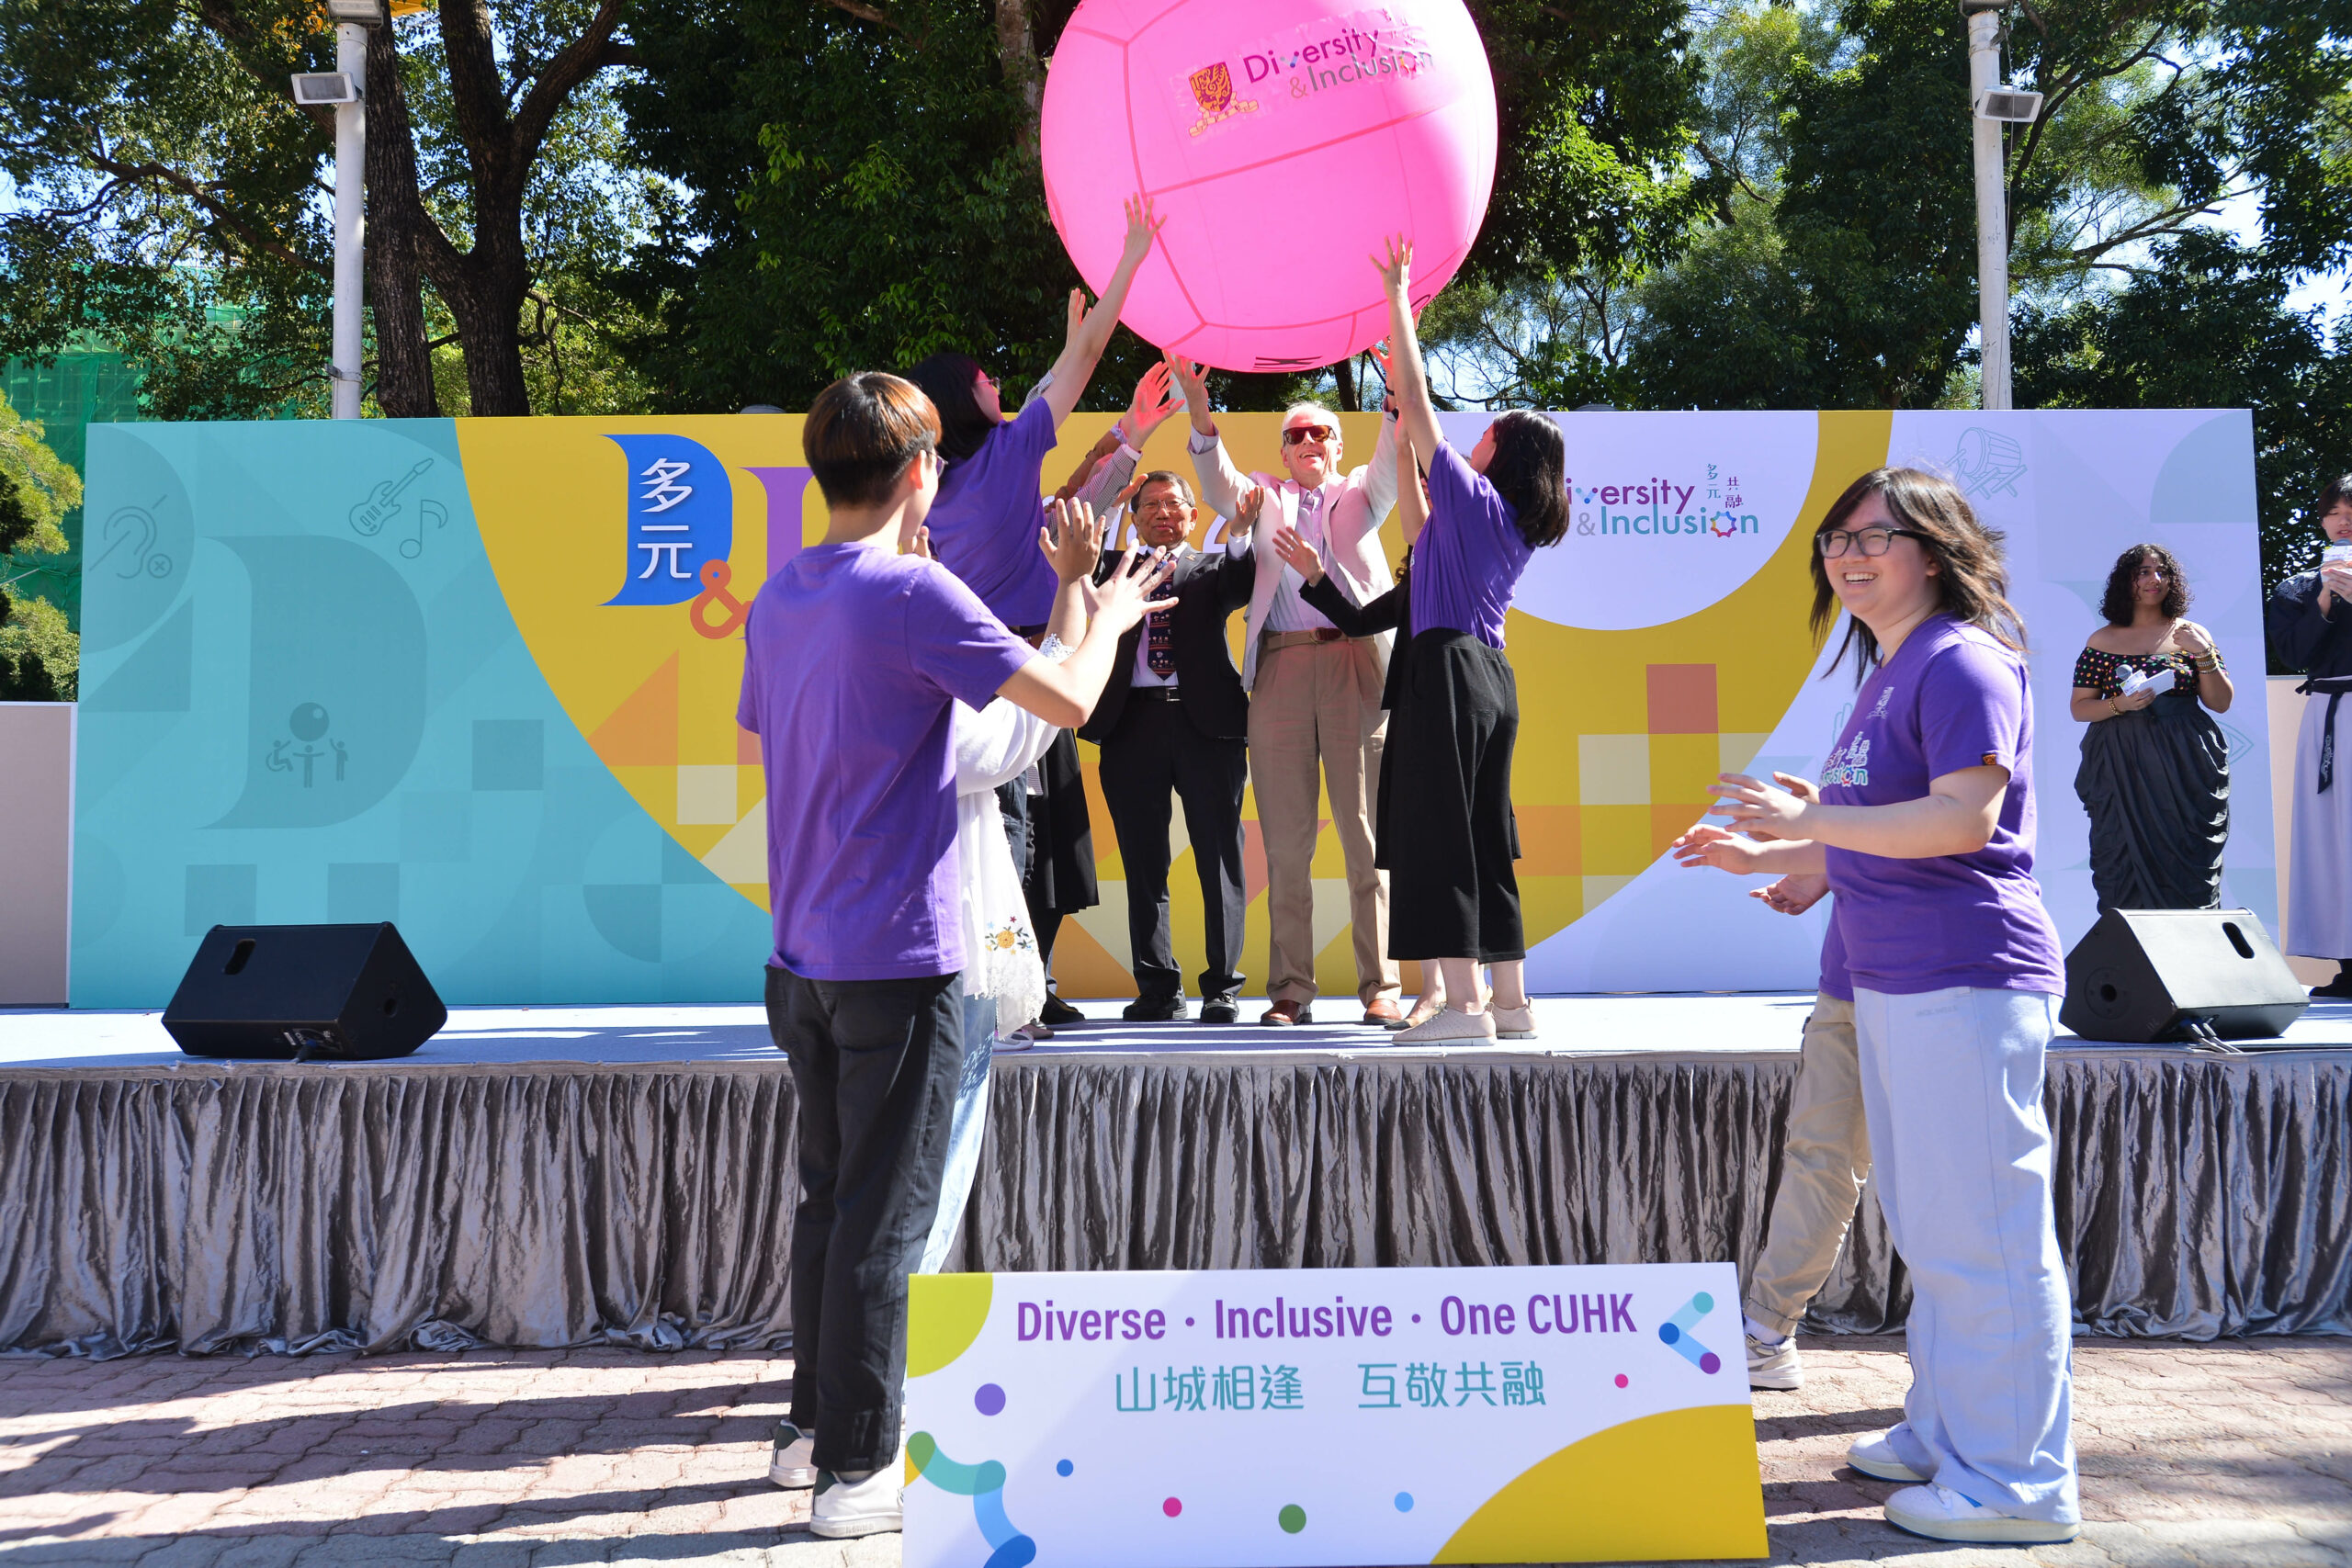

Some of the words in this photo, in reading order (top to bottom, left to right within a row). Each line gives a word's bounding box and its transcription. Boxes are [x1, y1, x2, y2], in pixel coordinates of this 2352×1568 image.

[1243, 28, 1379, 84] Diversity
[1307, 48, 1433, 92] Inclusion
[1566, 477, 1695, 515] iversity
[1706, 463, 1721, 500] 多元
[1725, 476, 1744, 509] 共融
[637, 457, 694, 580] 多元
[1600, 504, 1759, 538] Inclusion
[1018, 1301, 1166, 1341] Diverse
[1216, 1296, 1393, 1338] Inclusive
[1441, 1295, 1516, 1336] One
[1527, 1292, 1639, 1335] CUHK
[1115, 1365, 1305, 1412] 山城相逢
[1357, 1360, 1547, 1409] 互敬共融
